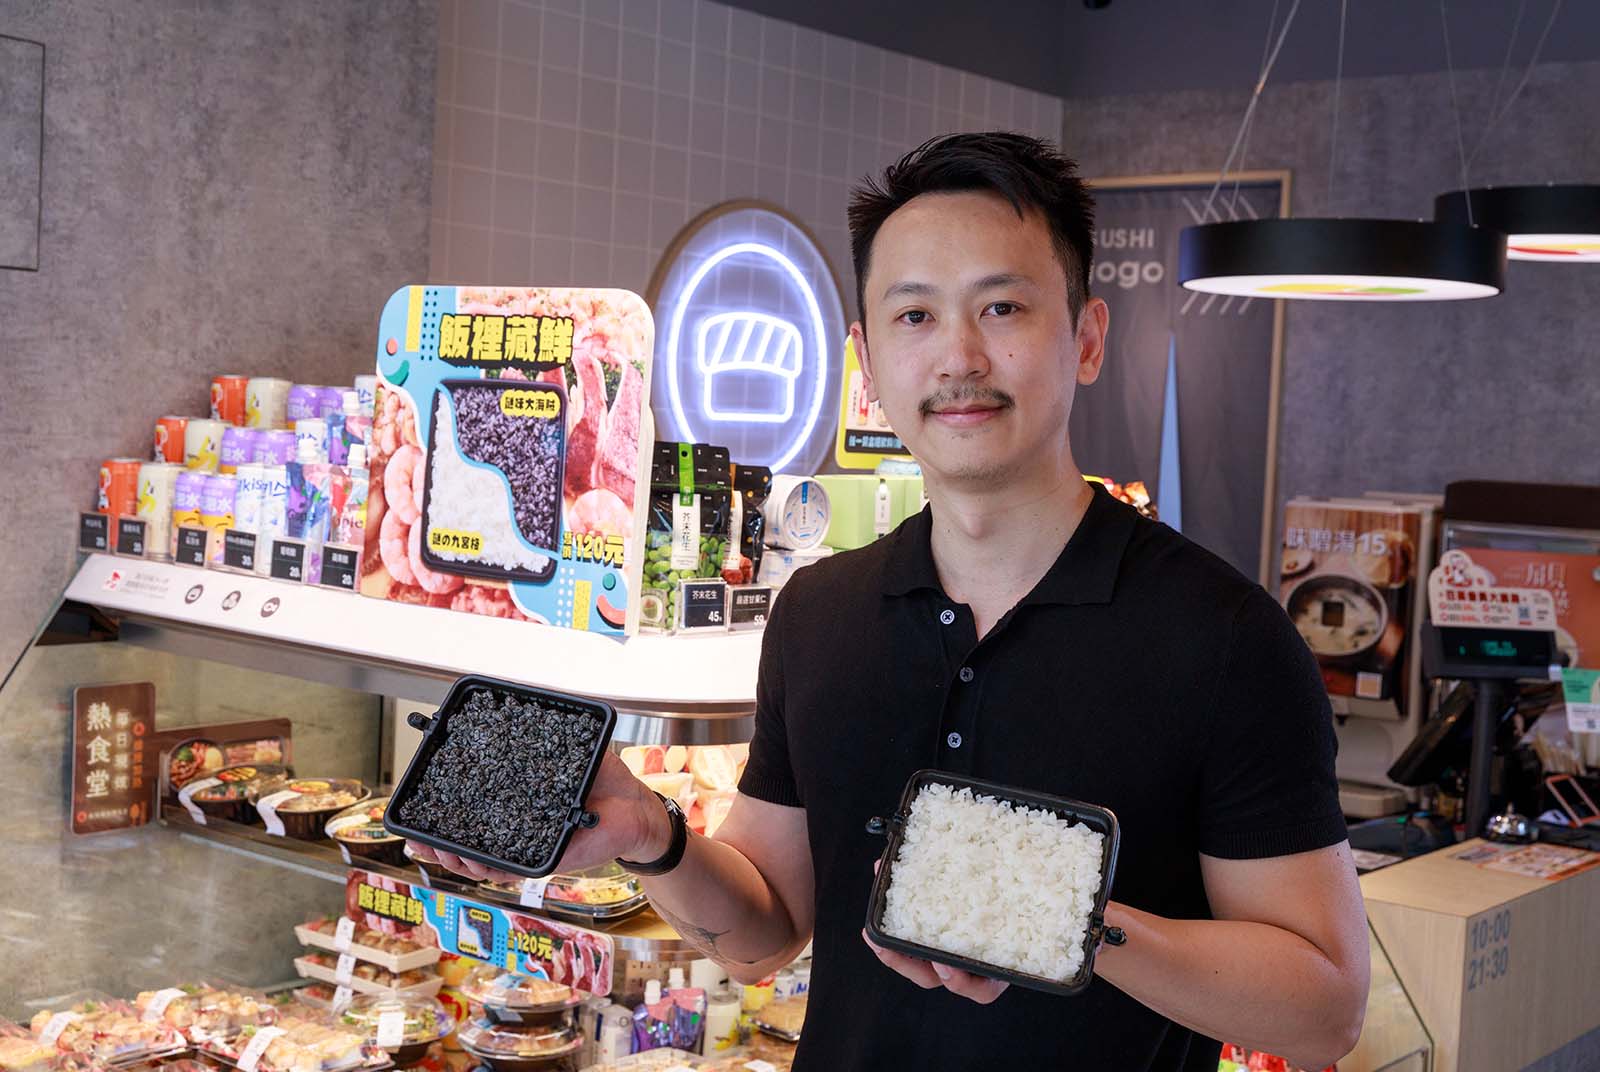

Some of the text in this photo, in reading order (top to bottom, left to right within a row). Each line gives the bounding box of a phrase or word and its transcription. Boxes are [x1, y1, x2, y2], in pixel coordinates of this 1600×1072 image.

[1088, 261, 1164, 289] ogo
[439, 315, 574, 364] 飯裡藏鮮
[575, 533, 625, 568] 120元
[692, 590, 718, 600] 芥末花生
[86, 701, 112, 798] 熱食堂
[358, 882, 424, 925] 飯裡藏鮮
[1471, 908, 1511, 952] 10:00
[1467, 945, 1509, 992] 21:30
